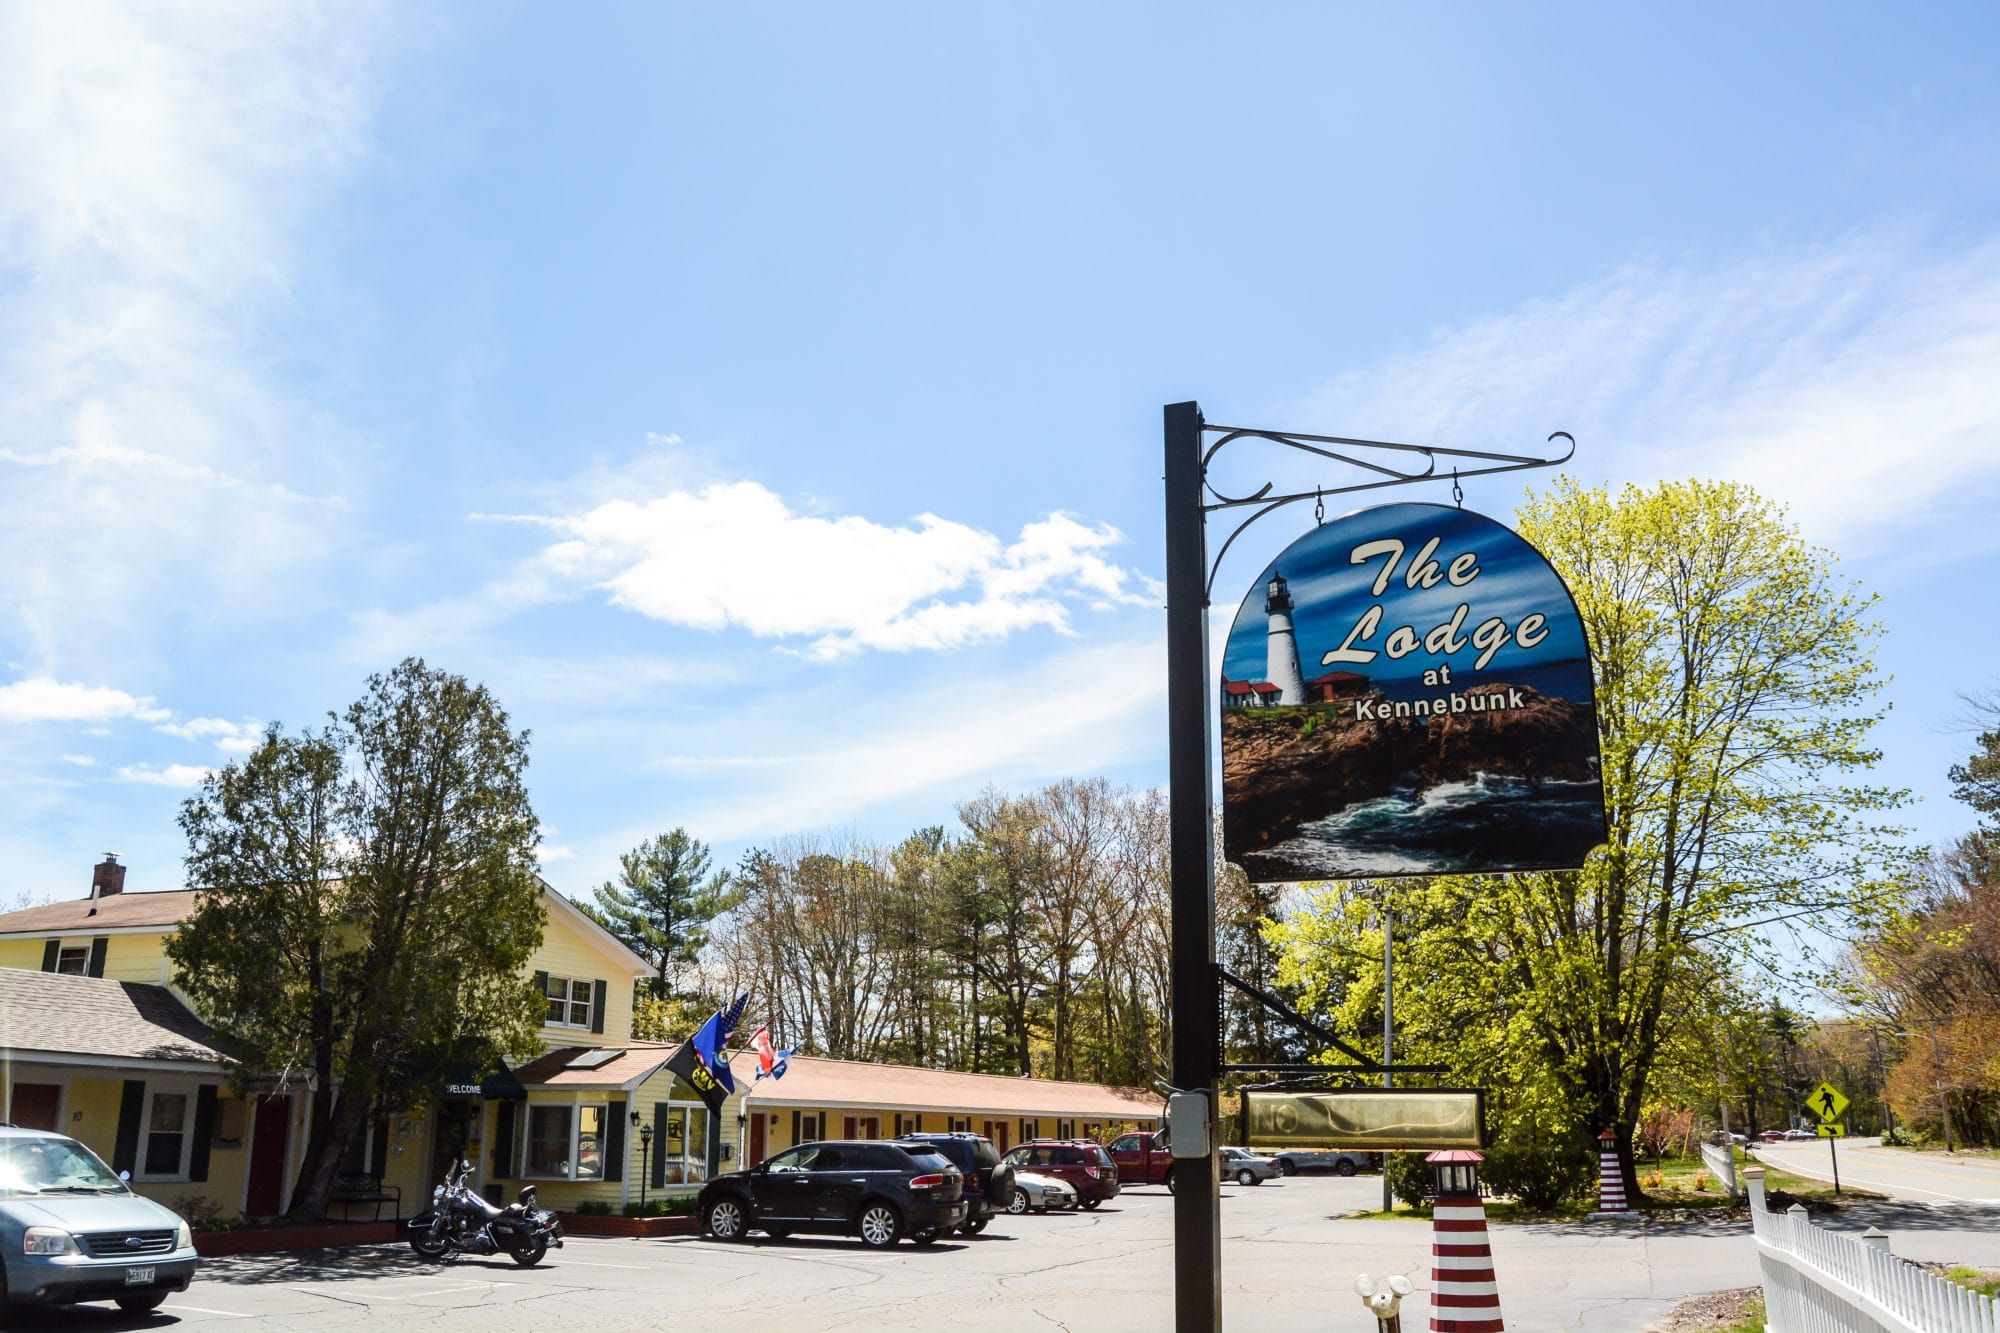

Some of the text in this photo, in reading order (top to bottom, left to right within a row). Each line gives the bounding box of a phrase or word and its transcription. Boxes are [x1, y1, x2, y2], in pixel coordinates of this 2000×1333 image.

[1350, 536, 1481, 597] The
[1321, 603, 1550, 671] Lodge
[1423, 663, 1451, 687] at
[1355, 687, 1526, 722] Kennebunk
[446, 1084, 482, 1094] WELCOME
[1255, 1103, 1299, 1134] NO
